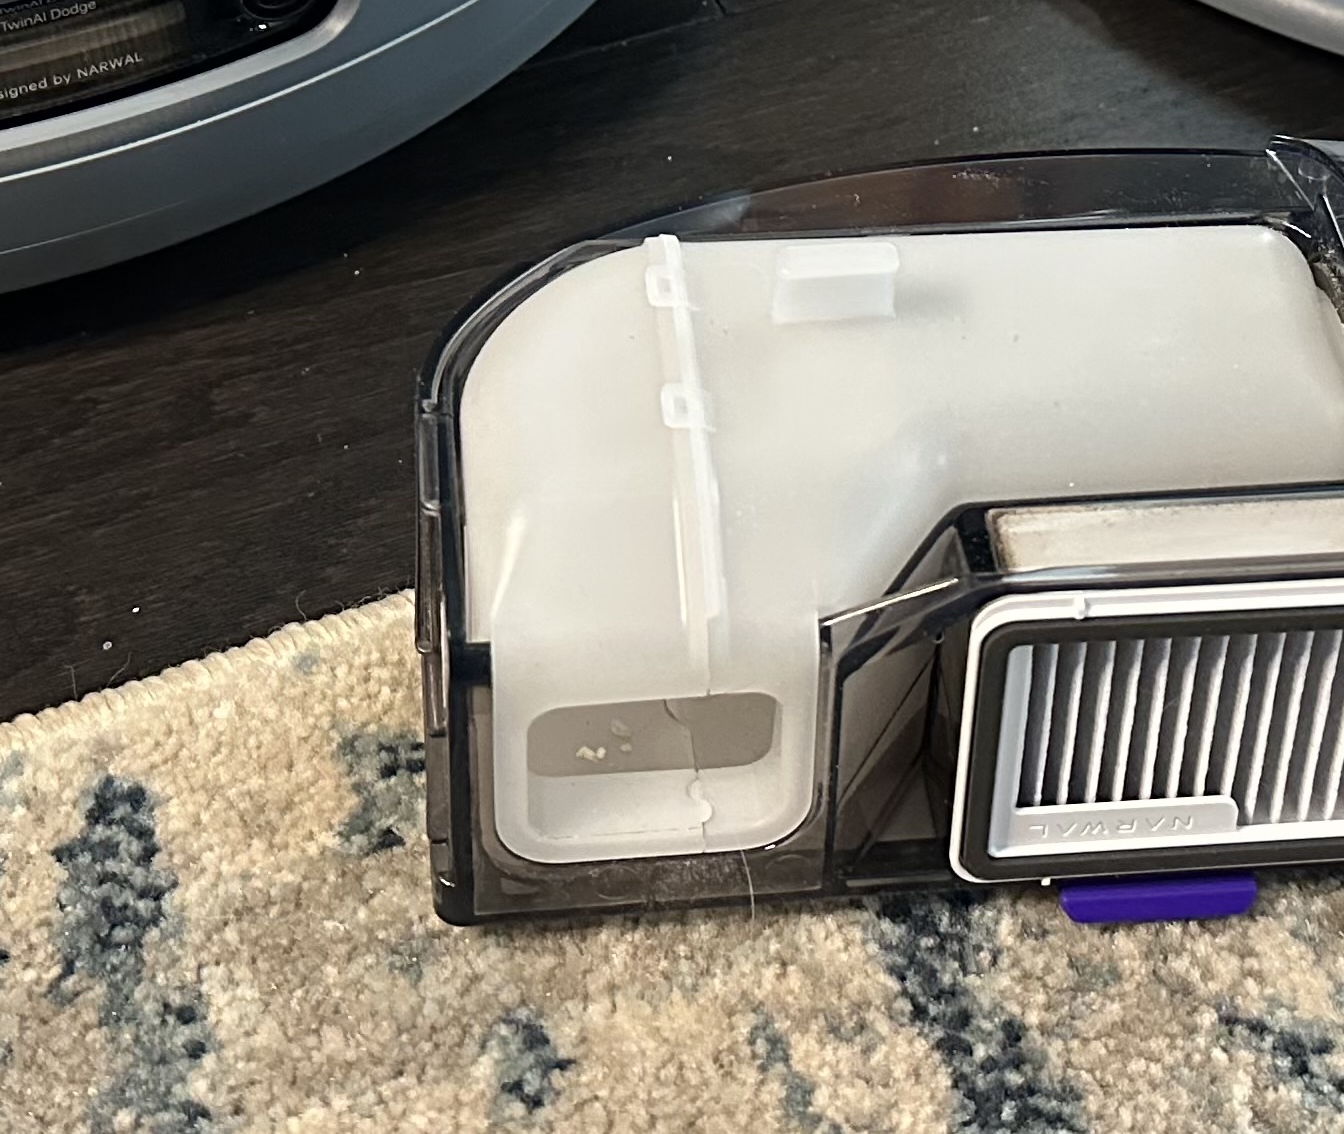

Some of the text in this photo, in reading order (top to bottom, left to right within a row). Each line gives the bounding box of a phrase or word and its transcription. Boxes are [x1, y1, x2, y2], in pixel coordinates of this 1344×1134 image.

[50, 0, 97, 21] Dodge
[53, 74, 72, 85] by
[77, 52, 144, 78] NARWAL
[1030, 816, 1193, 838] NARWAL
